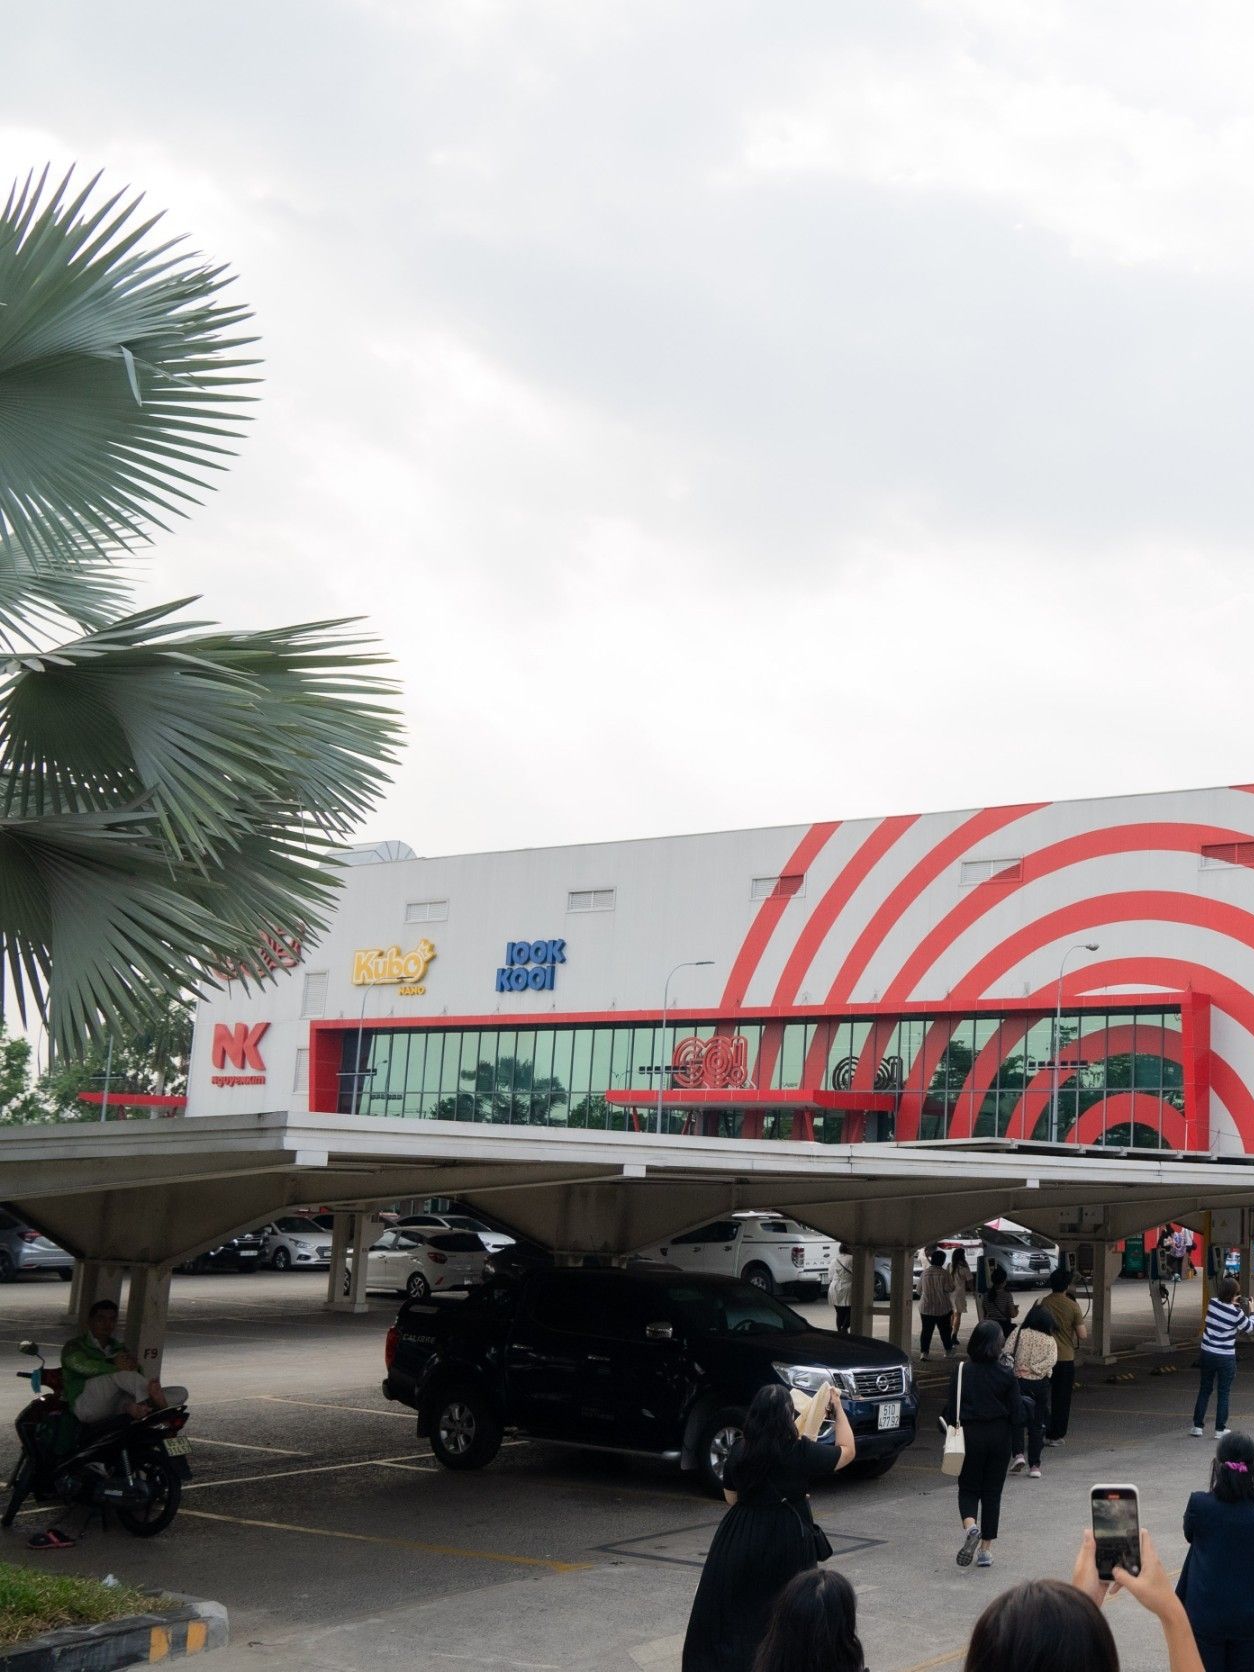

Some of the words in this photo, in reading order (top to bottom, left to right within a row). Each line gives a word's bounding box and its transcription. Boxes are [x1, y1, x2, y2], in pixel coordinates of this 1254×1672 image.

[352, 944, 430, 985] Kubo
[211, 1022, 272, 1071] NK
[673, 1035, 749, 1089] GO!
[144, 1348, 158, 1359] F9
